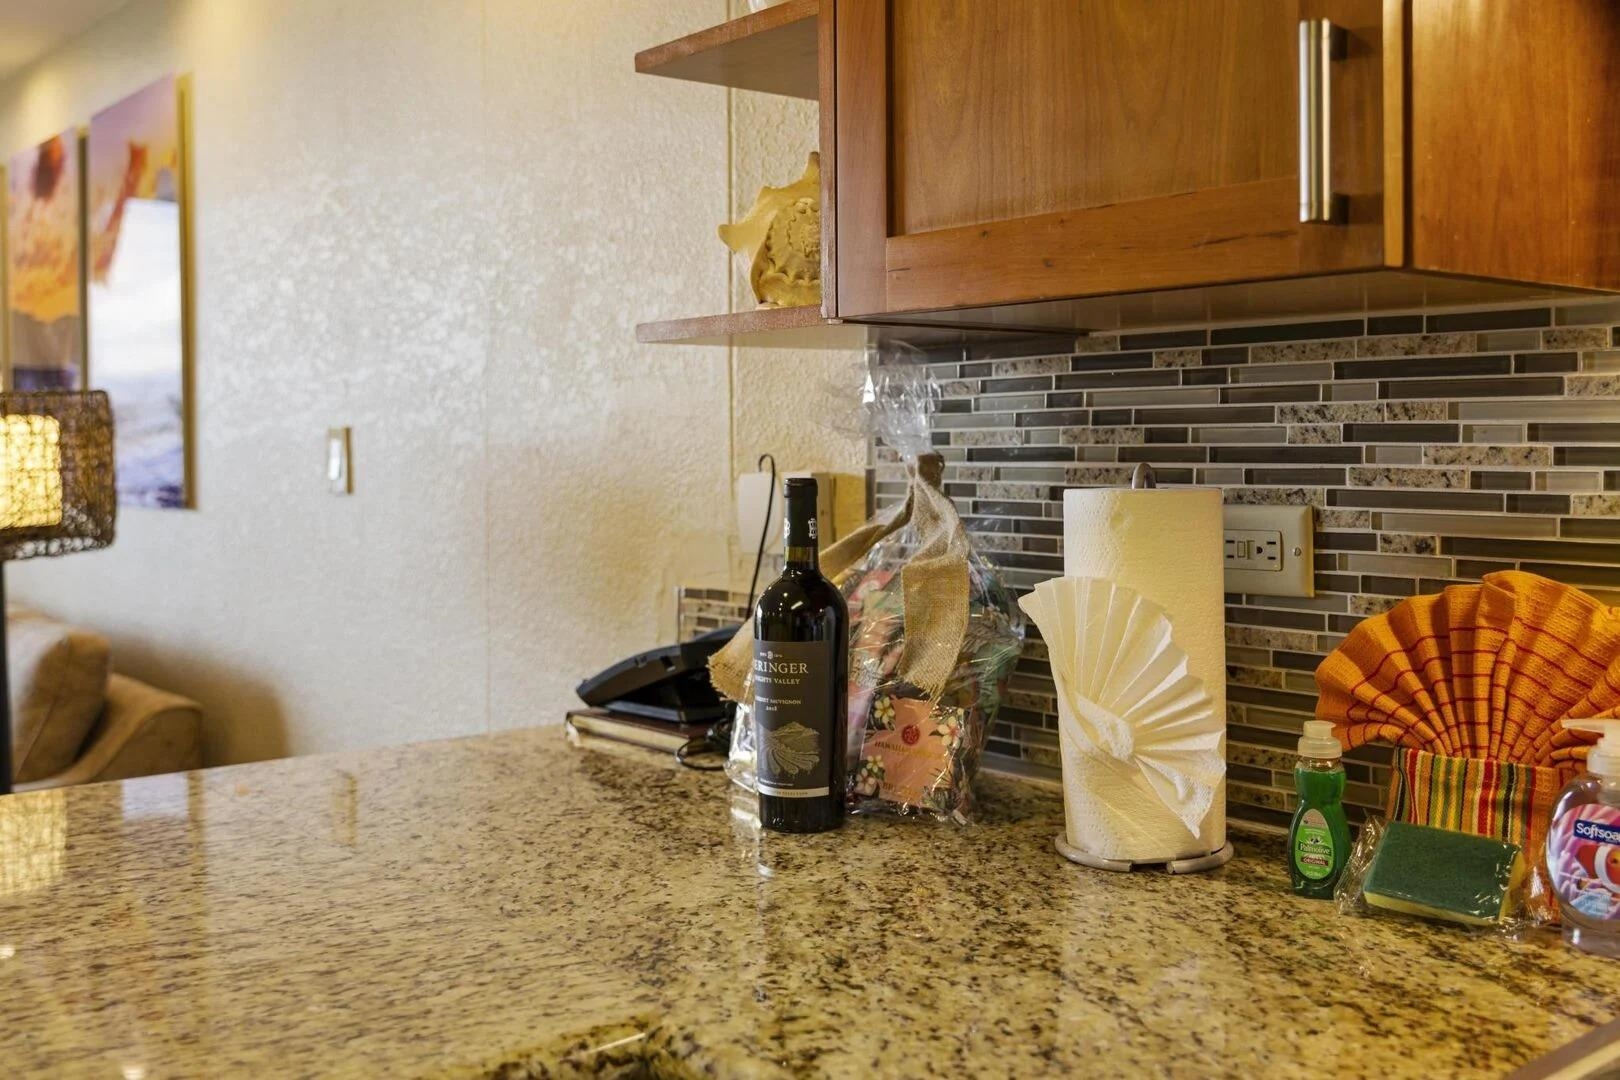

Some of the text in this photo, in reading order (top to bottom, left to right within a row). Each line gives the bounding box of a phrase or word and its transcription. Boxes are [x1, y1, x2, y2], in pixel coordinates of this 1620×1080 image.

[754, 659, 809, 674] ERINGER
[1576, 823, 1620, 840] Softsoa
[1300, 843, 1330, 854] Palmolive
